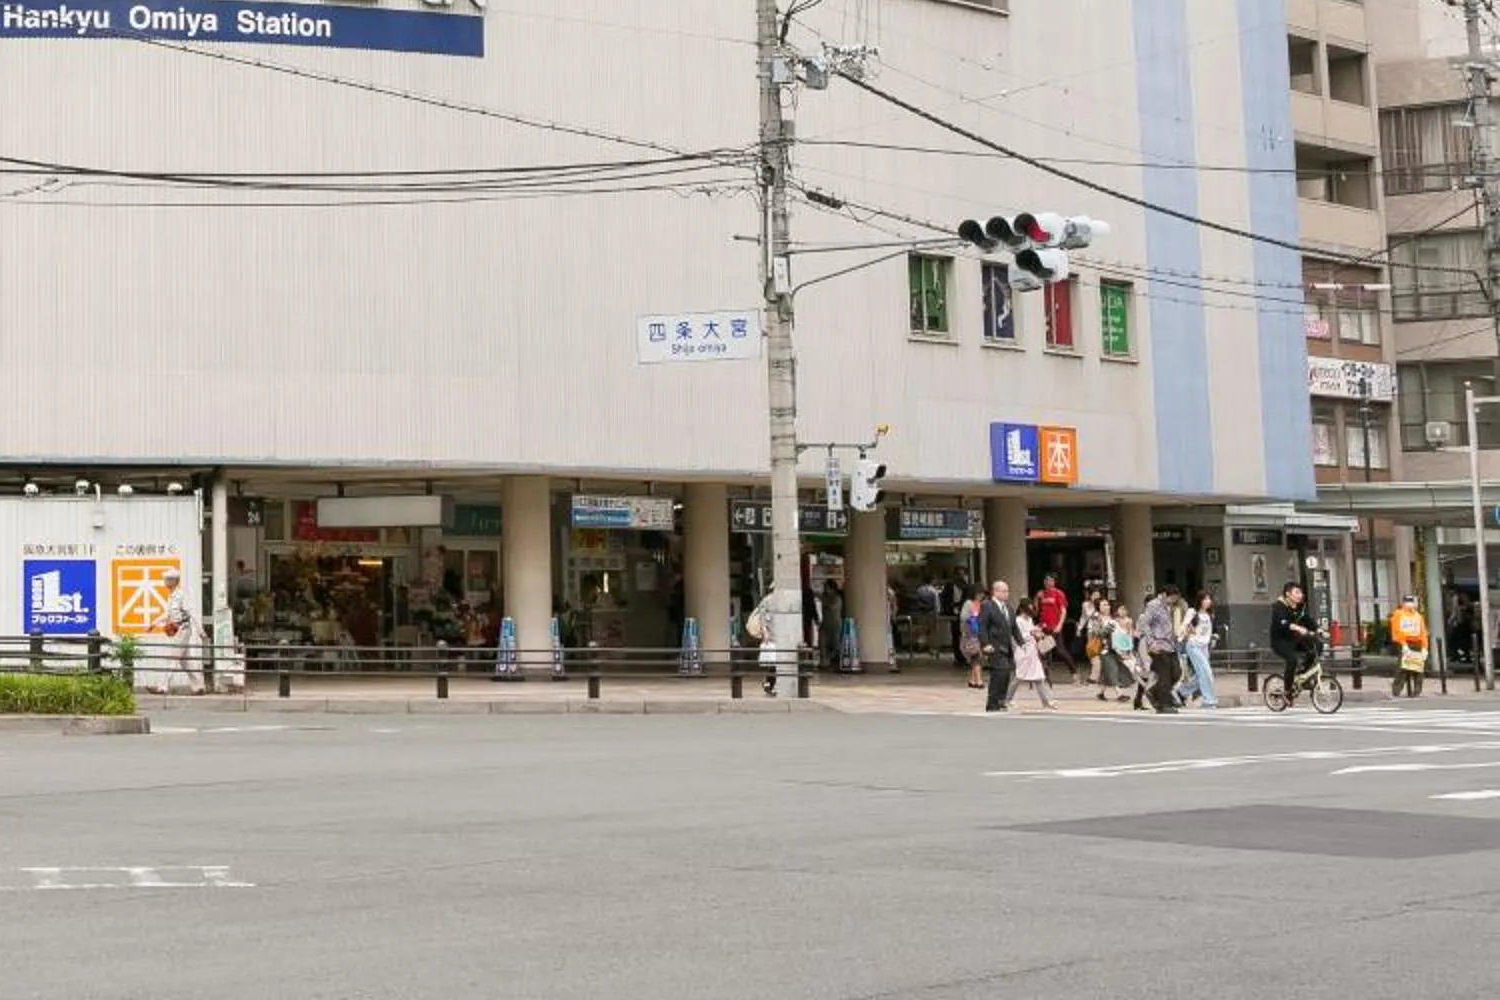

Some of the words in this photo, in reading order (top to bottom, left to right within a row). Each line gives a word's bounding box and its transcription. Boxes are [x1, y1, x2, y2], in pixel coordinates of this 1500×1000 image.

[2, 4, 111, 35] Hankyu
[128, 6, 219, 37] Omiya
[236, 9, 332, 38] Station
[648, 318, 748, 342] 四条大宮
